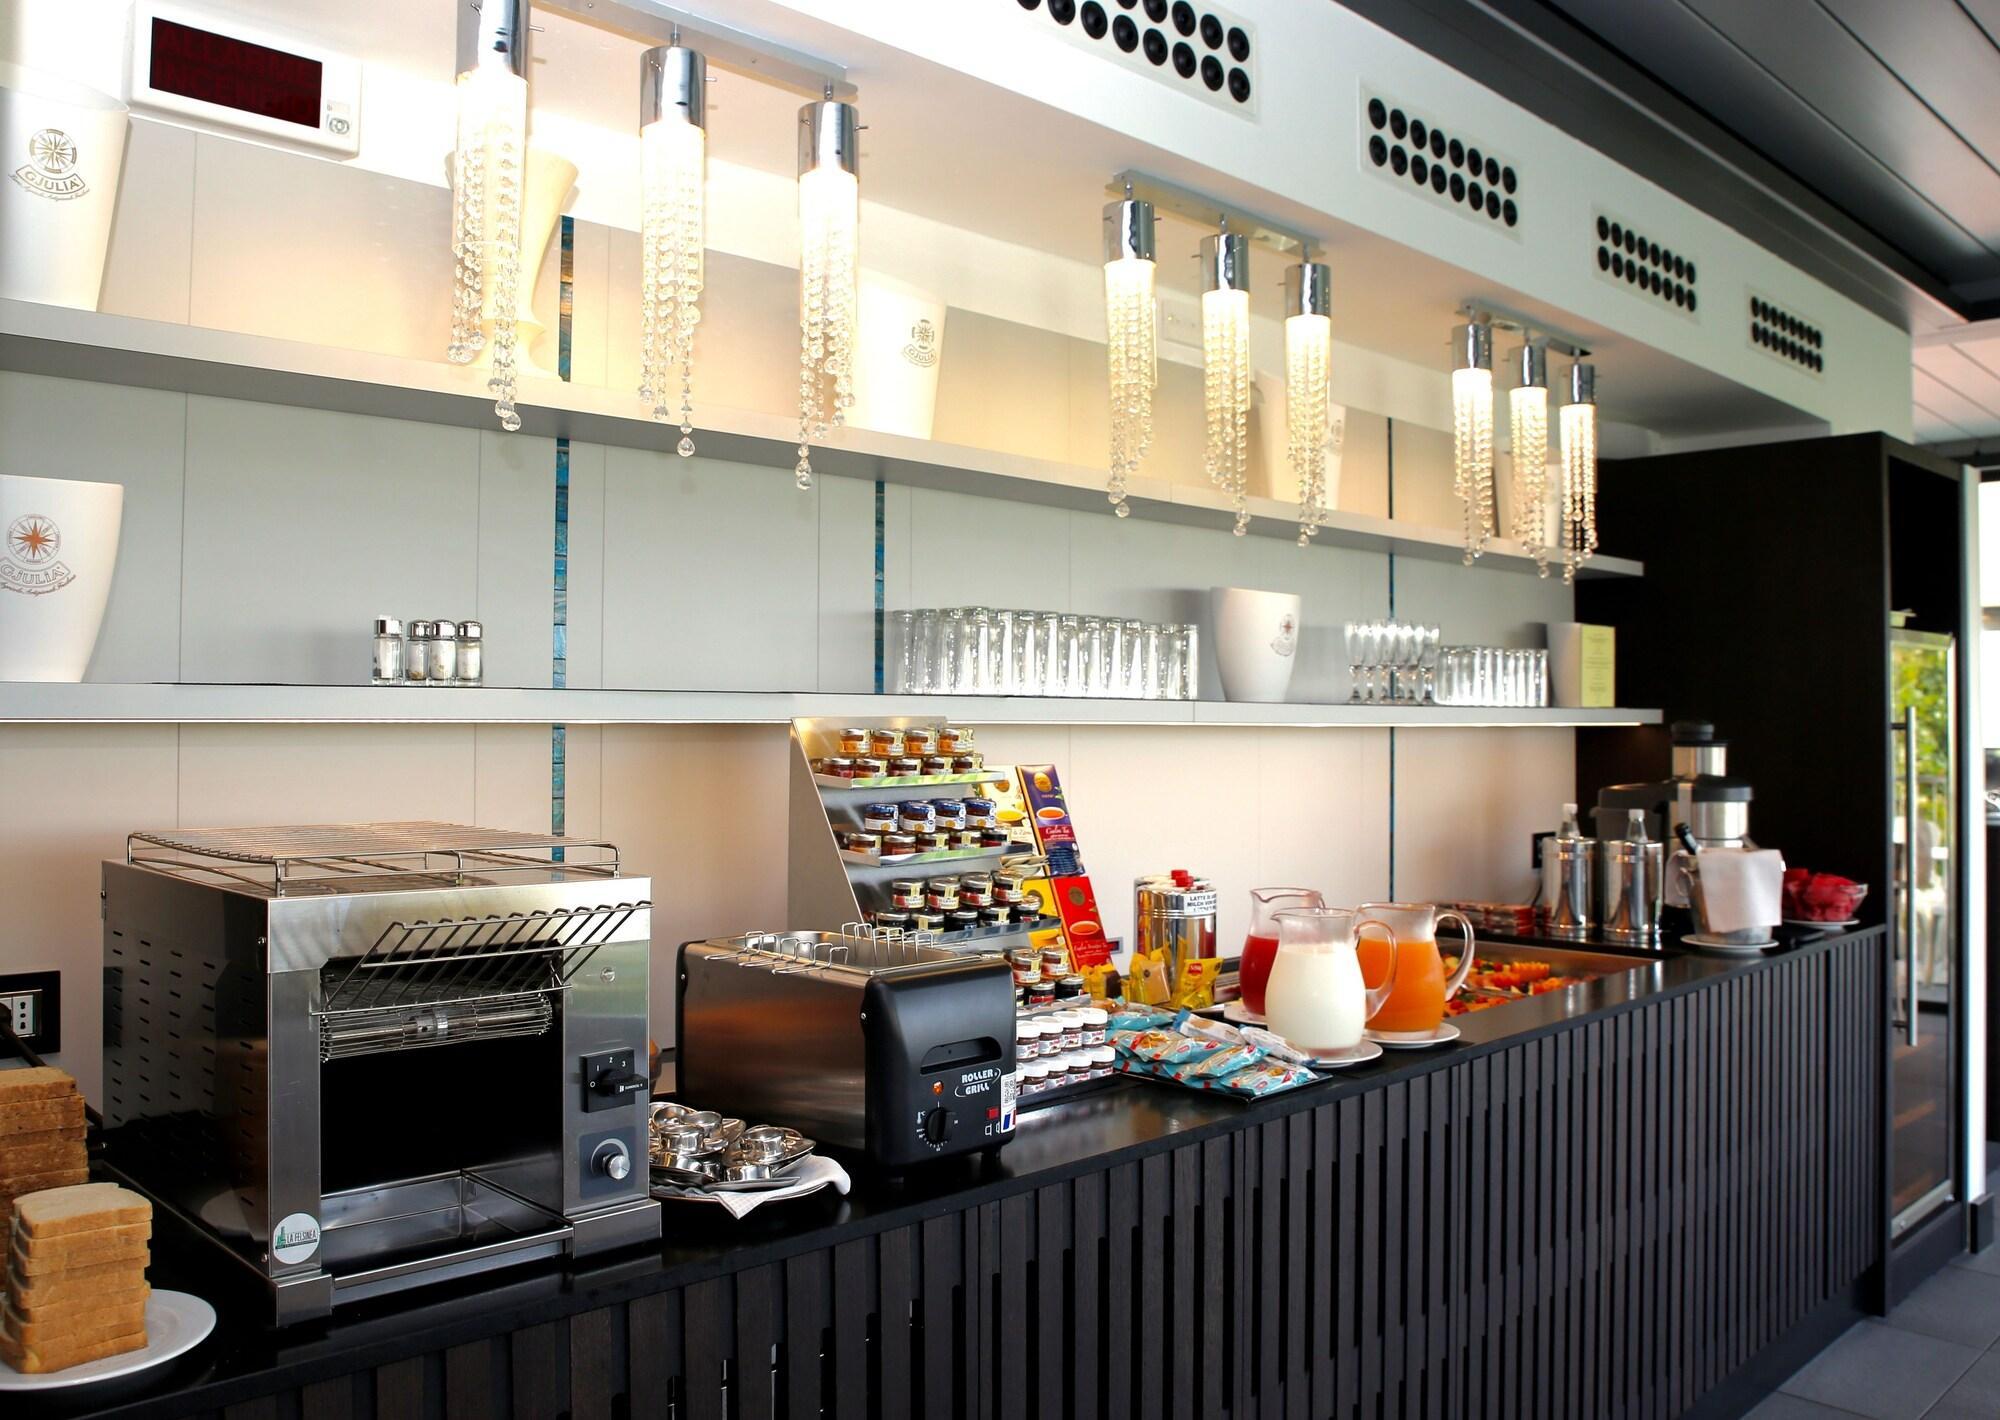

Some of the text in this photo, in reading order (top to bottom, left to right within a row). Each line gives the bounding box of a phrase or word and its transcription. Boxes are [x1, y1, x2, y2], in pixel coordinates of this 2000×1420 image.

[24, 170, 80, 192] GJULIA
[0, 563, 65, 585] GJULIA
[961, 1069, 993, 1083] ROLLER
[965, 1082, 990, 1095] GRILL
[287, 1232, 294, 1243] LA
